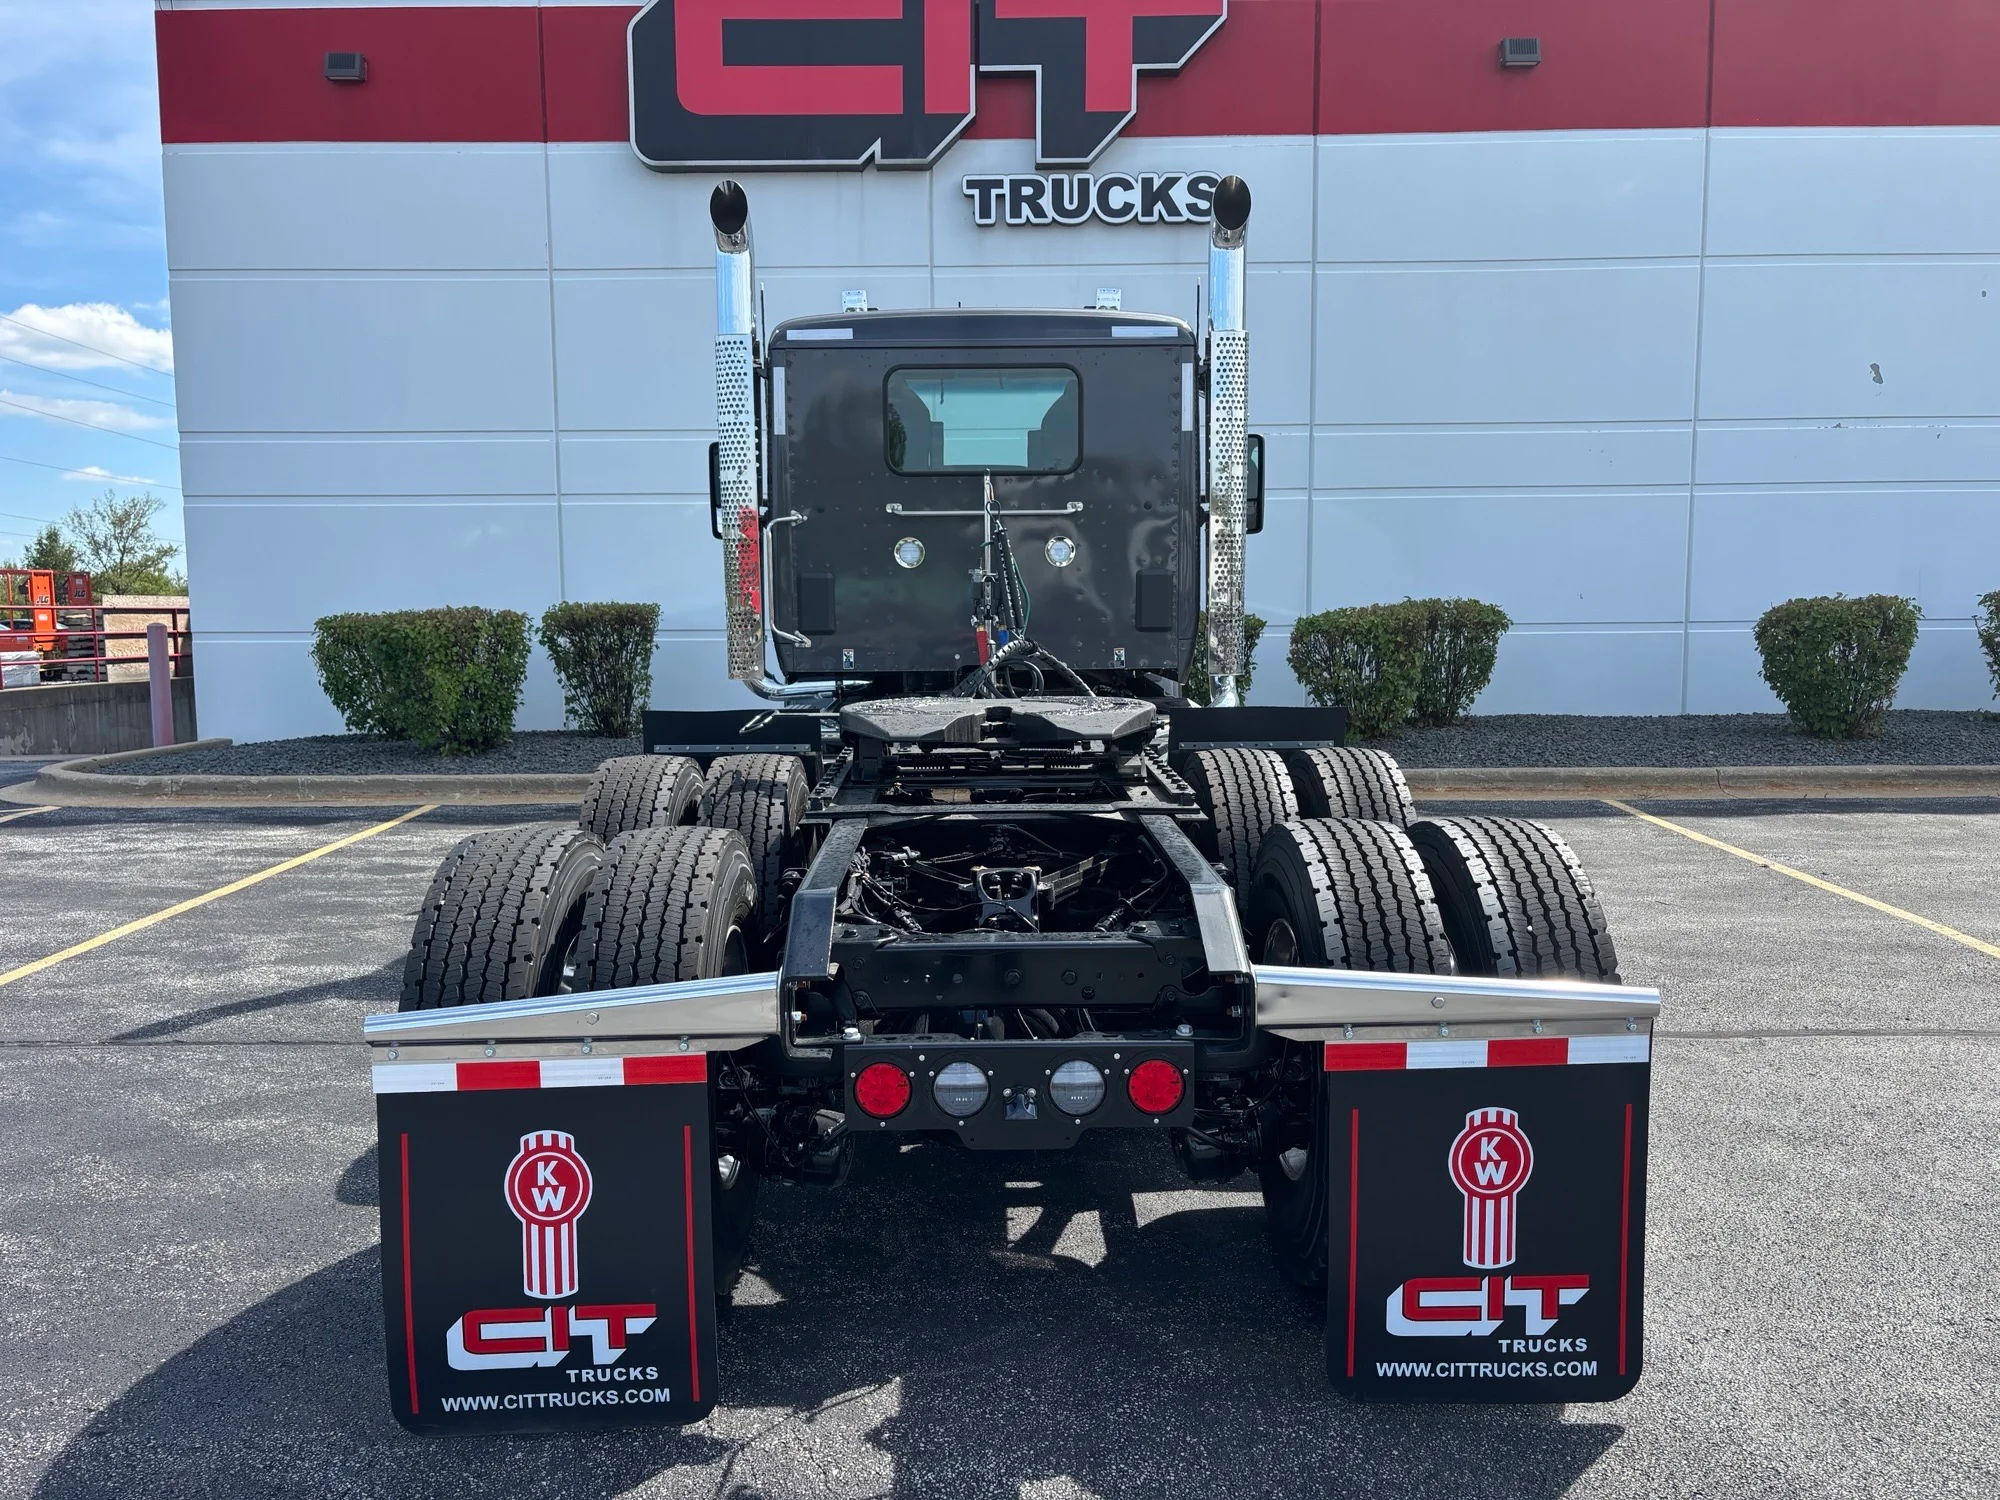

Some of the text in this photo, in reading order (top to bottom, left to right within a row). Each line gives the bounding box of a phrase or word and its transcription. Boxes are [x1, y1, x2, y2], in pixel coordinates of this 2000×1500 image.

[628, 0, 1228, 168] CIT
[963, 173, 1217, 224] TRUCKS
[36, 595, 49, 604] JLG
[1386, 1274, 1590, 1337] CIT
[446, 1303, 658, 1371] CIT
[1498, 1337, 1588, 1354] TRUCKS
[565, 1366, 659, 1383] TRUCKS
[1375, 1360, 1598, 1379] WWW.CITTRUCKS.COM
[441, 1387, 671, 1413] WWW.CITTRUCKS.COM
